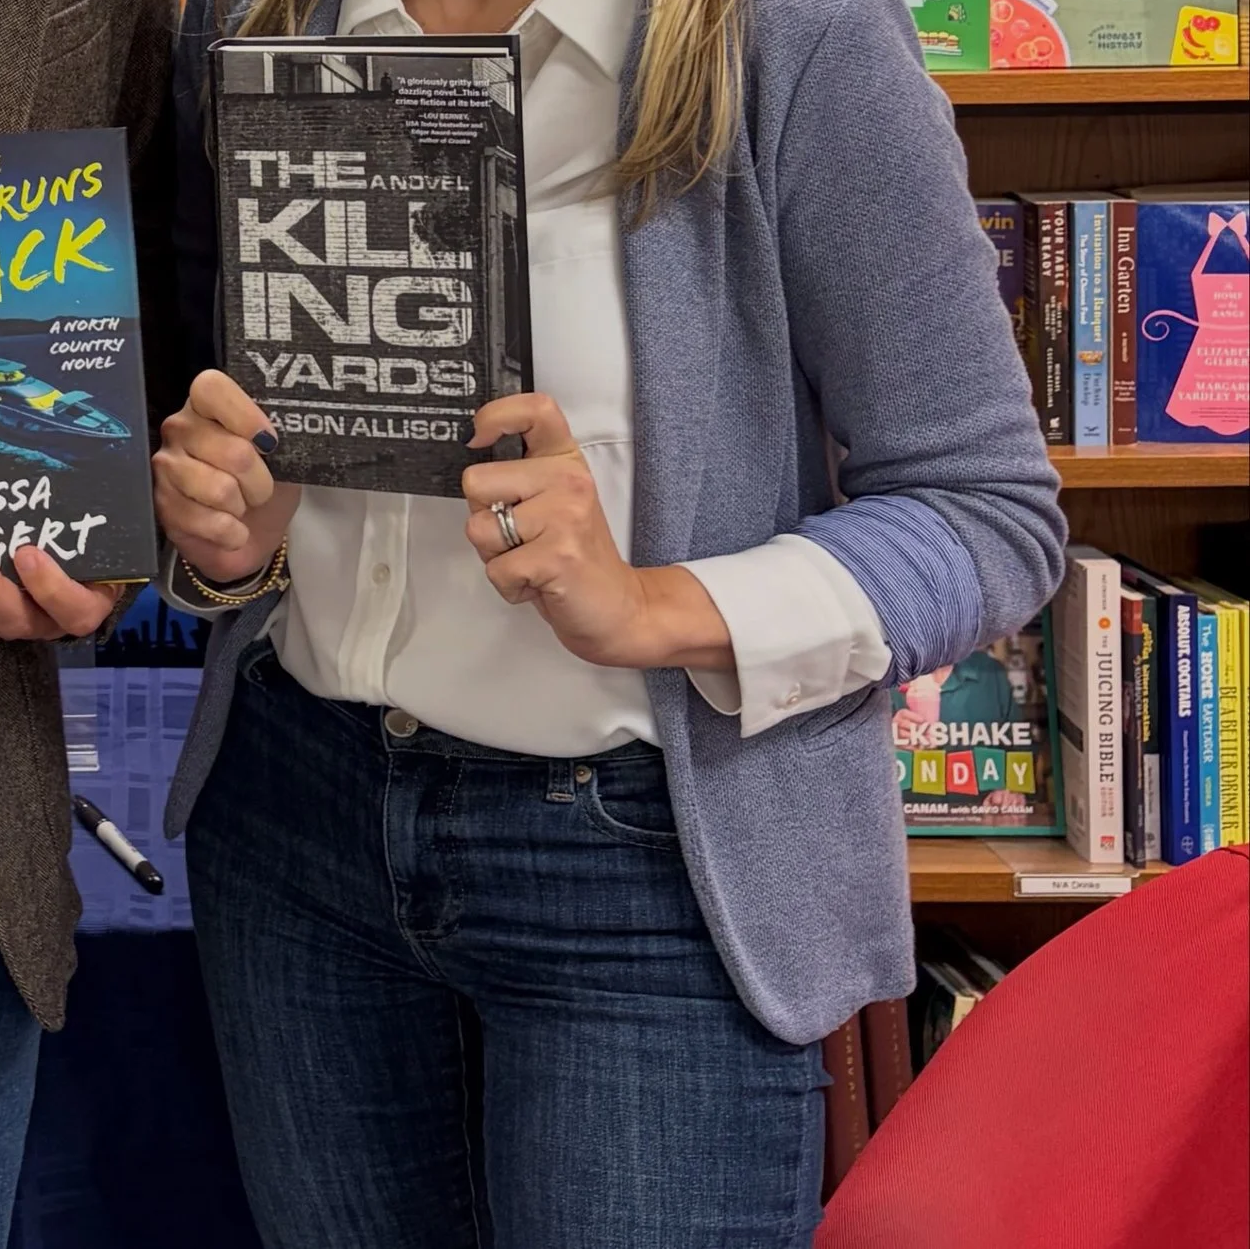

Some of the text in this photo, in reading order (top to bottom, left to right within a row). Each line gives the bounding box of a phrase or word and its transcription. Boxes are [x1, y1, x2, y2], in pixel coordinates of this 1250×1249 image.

[1098, 31, 1143, 41] HONEST
[1098, 41, 1143, 51] HISTORY
[398, 87, 432, 97] dazzling
[407, 78, 472, 88] gloriously gritty
[420, 98, 446, 106] fiction
[234, 150, 470, 192] THE A NOVEL
[237, 197, 473, 270] KILL
[1054, 209, 1065, 244] YOUR
[1041, 219, 1052, 277] IS READY
[1054, 250, 1065, 287] TABLE
[1091, 214, 1105, 343] Invitation to Banquet
[1117, 226, 1135, 314] Ina Garten
[50, 316, 121, 334] A NORTH
[240, 271, 473, 348] ING
[49, 337, 125, 355] COUNTRY
[61, 354, 117, 371] NOVEL
[244, 352, 478, 396] YARDS
[1177, 659, 1193, 718] COCKTAILS
[1200, 623, 1215, 764] The HOME BARTENDER
[892, 721, 1033, 747] LKSHAKE
[1096, 651, 1115, 783] JUICING BIBLE
[1219, 686, 1240, 831] BE A BETTER DRINKER
[903, 802, 949, 815] CANAM
